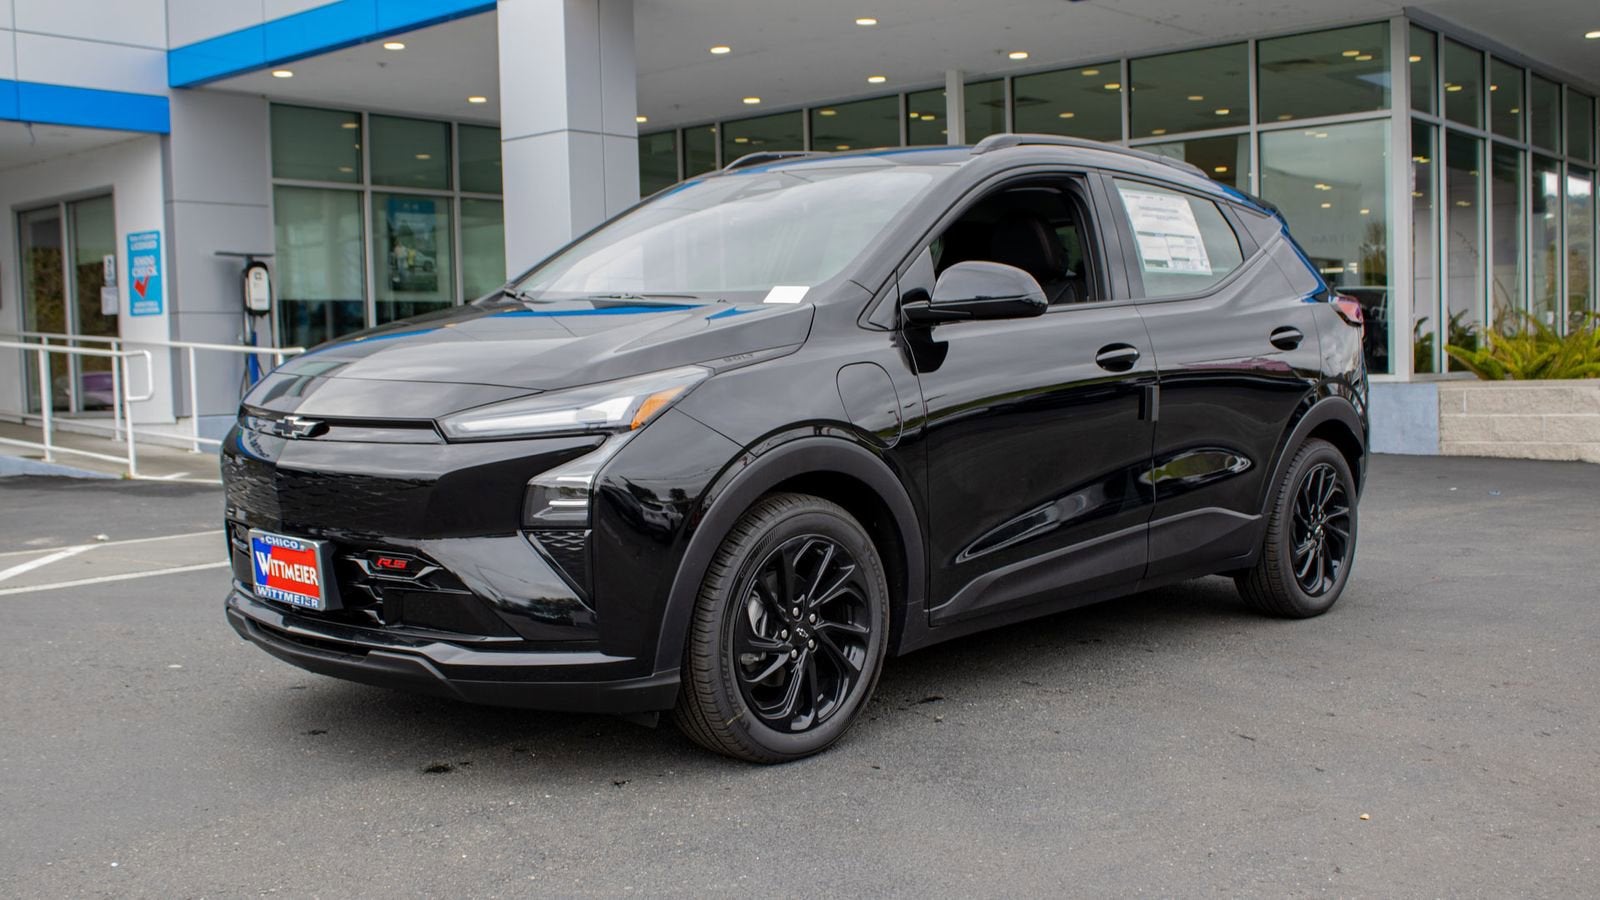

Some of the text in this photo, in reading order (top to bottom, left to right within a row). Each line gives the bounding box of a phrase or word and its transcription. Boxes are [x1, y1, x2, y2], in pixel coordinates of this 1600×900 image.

[265, 535, 298, 549] CHICO
[255, 551, 319, 586] WITTMEIER
[376, 557, 407, 569] RS
[257, 587, 318, 608] WITTMEIER
